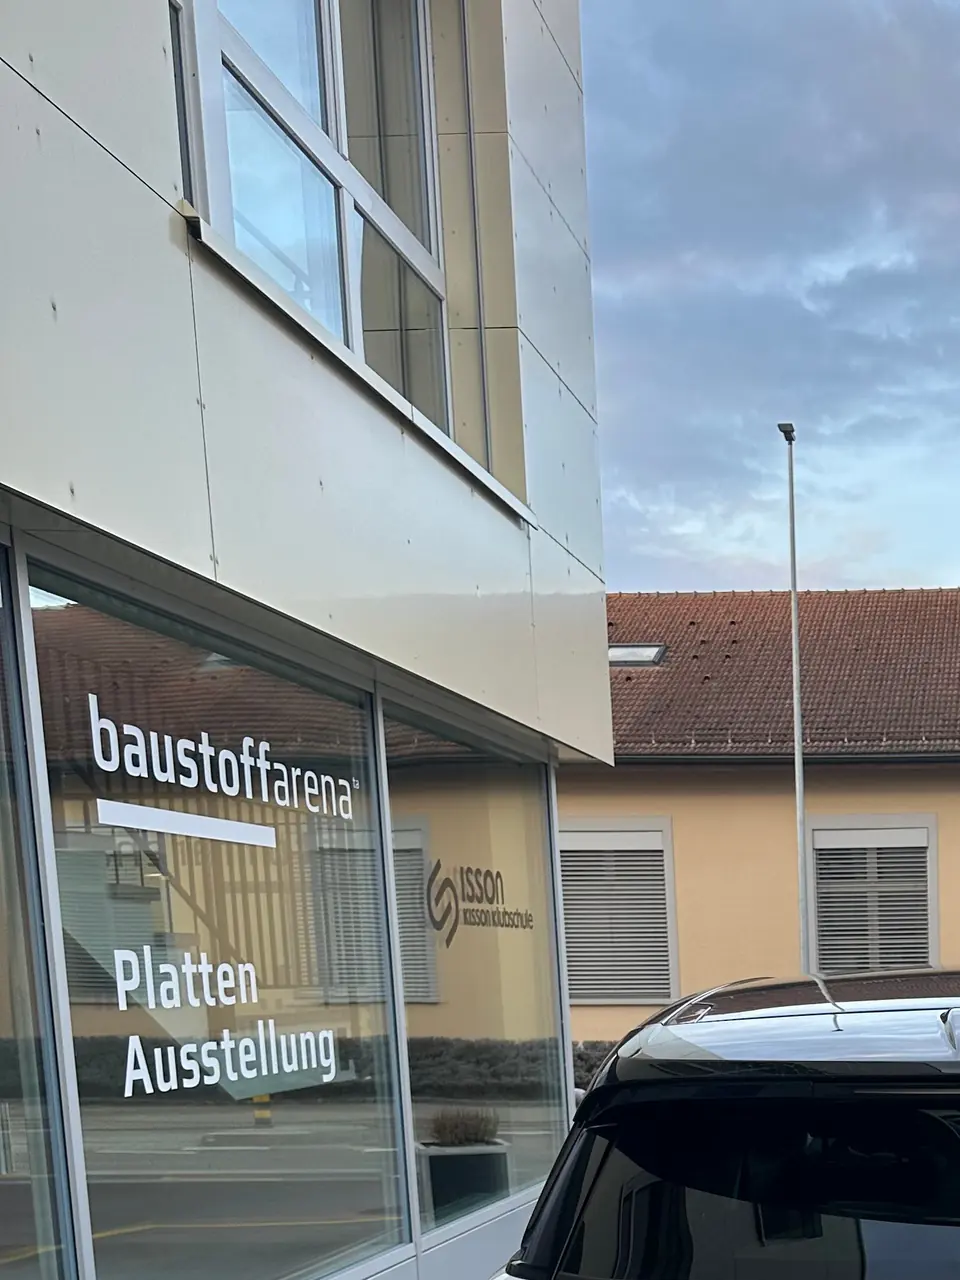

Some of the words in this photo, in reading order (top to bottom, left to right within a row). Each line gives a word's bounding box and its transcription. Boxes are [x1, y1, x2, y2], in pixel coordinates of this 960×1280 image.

[87, 692, 353, 820] baustoffarena
[113, 945, 259, 1011] Platten
[123, 1019, 338, 1098] Ausstellung
